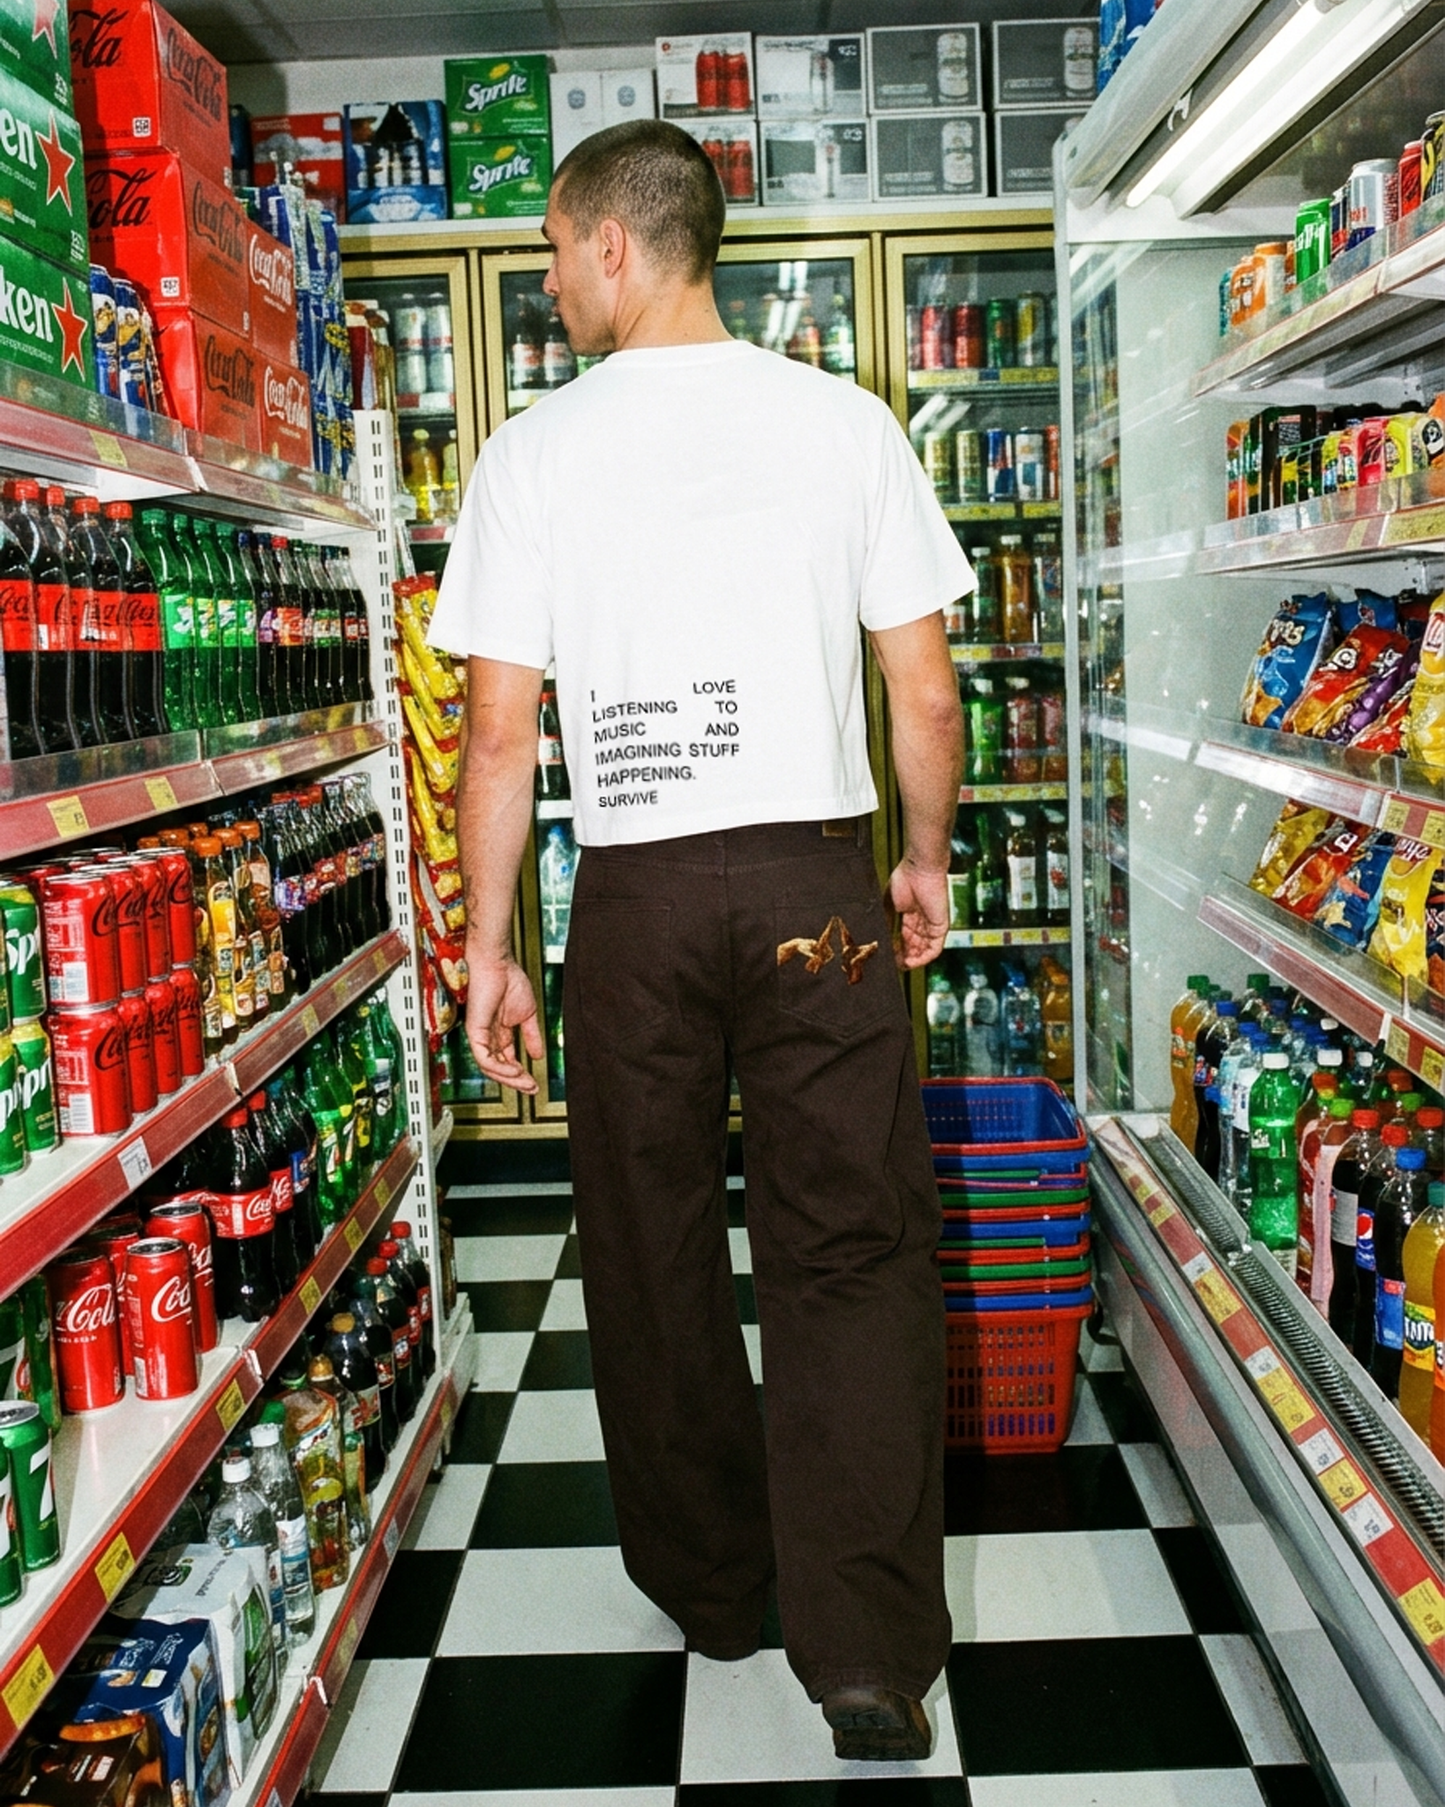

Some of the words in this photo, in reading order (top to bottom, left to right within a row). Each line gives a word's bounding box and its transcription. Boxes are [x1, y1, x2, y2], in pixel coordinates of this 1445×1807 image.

[465, 74, 527, 111] Sprite
[469, 155, 531, 192] Sprite
[590, 690, 595, 702] I
[693, 679, 736, 694] LOVE
[593, 700, 678, 723] LISTENING
[715, 701, 738, 714] TO
[594, 722, 646, 744] MUSIC
[705, 723, 739, 737] AND
[595, 742, 682, 766] IMAGINING
[689, 743, 740, 758] STUFF
[597, 766, 697, 788] HAPPENING.
[598, 790, 658, 808] SURVIVE
